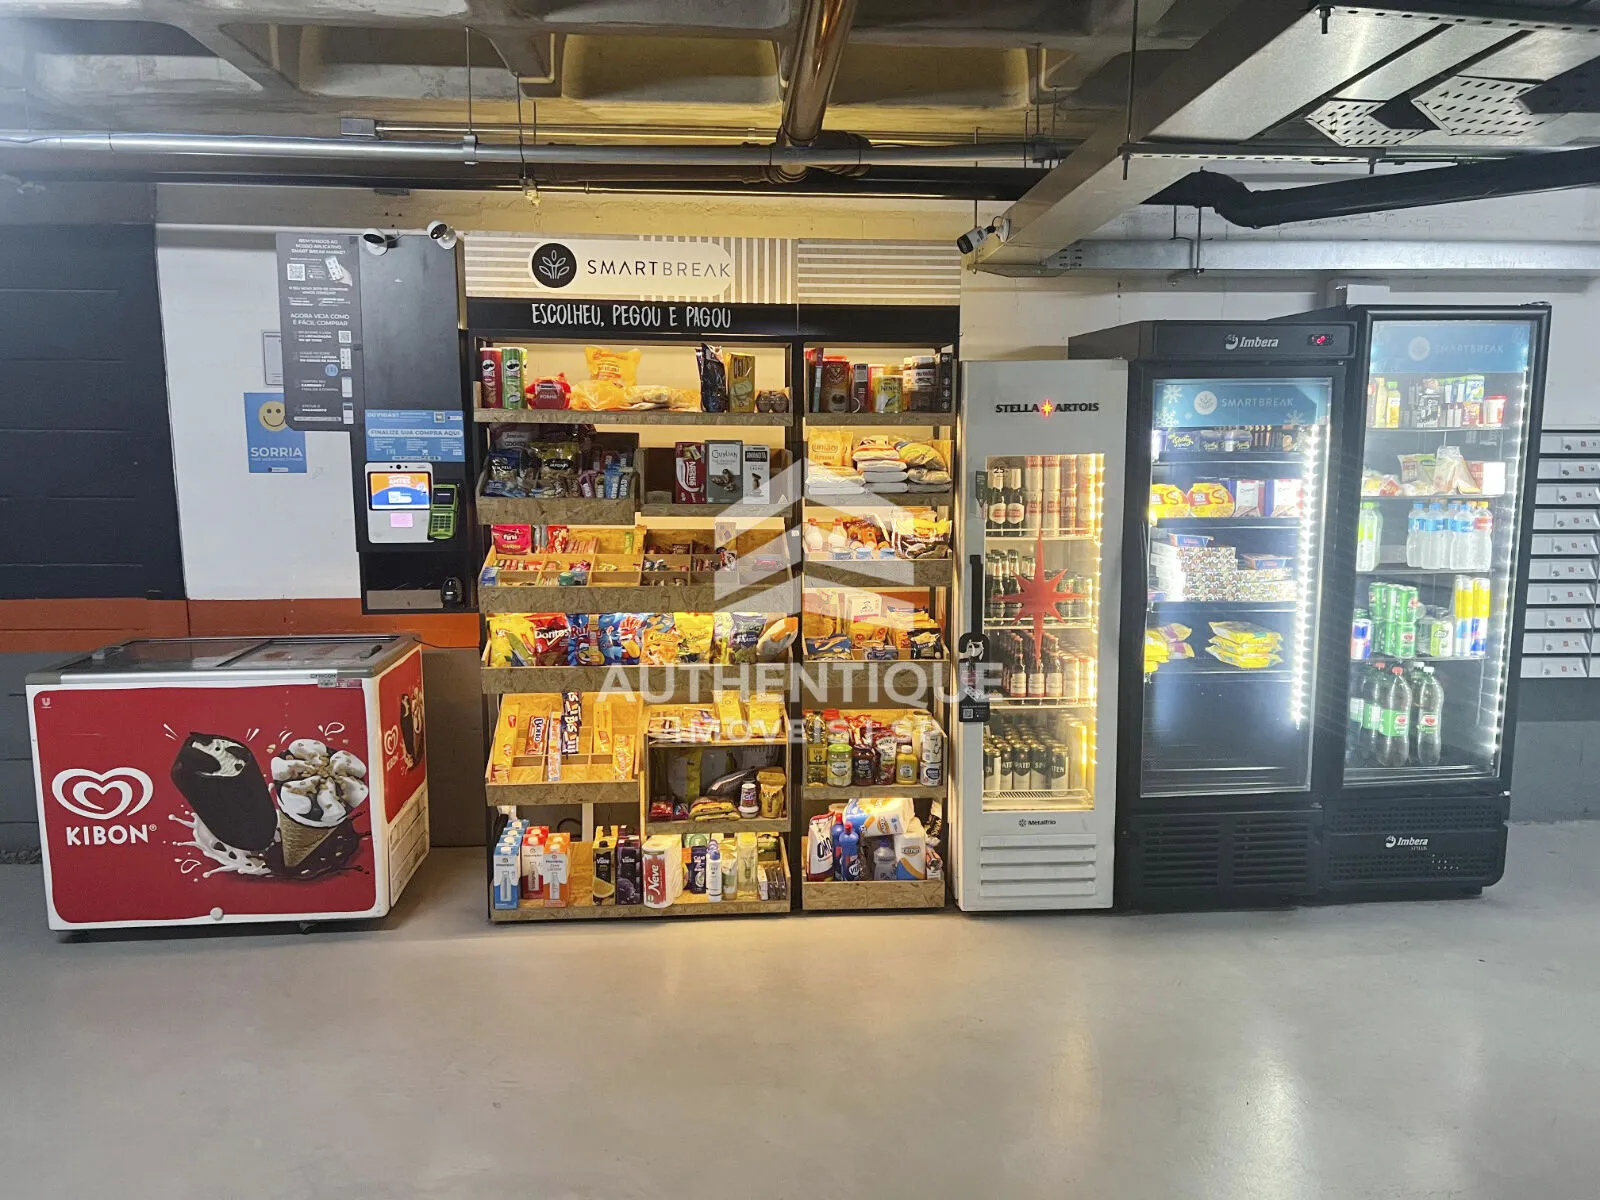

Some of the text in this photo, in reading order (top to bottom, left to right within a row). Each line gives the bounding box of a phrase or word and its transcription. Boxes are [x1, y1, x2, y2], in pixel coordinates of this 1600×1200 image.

[587, 258, 731, 278] SMARTBREAK
[316, 319, 349, 327] COMPRAR
[532, 303, 732, 329] ESCOLHEU, PEGOU E PAGOU
[1239, 334, 1280, 349] Imbera
[995, 401, 1100, 413] STELLA ARTOIS
[1221, 397, 1294, 408] SMARTBREAK
[250, 446, 304, 458] SORRIA
[534, 626, 570, 640] Doritos
[66, 825, 149, 846] KIBON
[1396, 836, 1429, 845] Imbera
[648, 864, 660, 896] Neve
